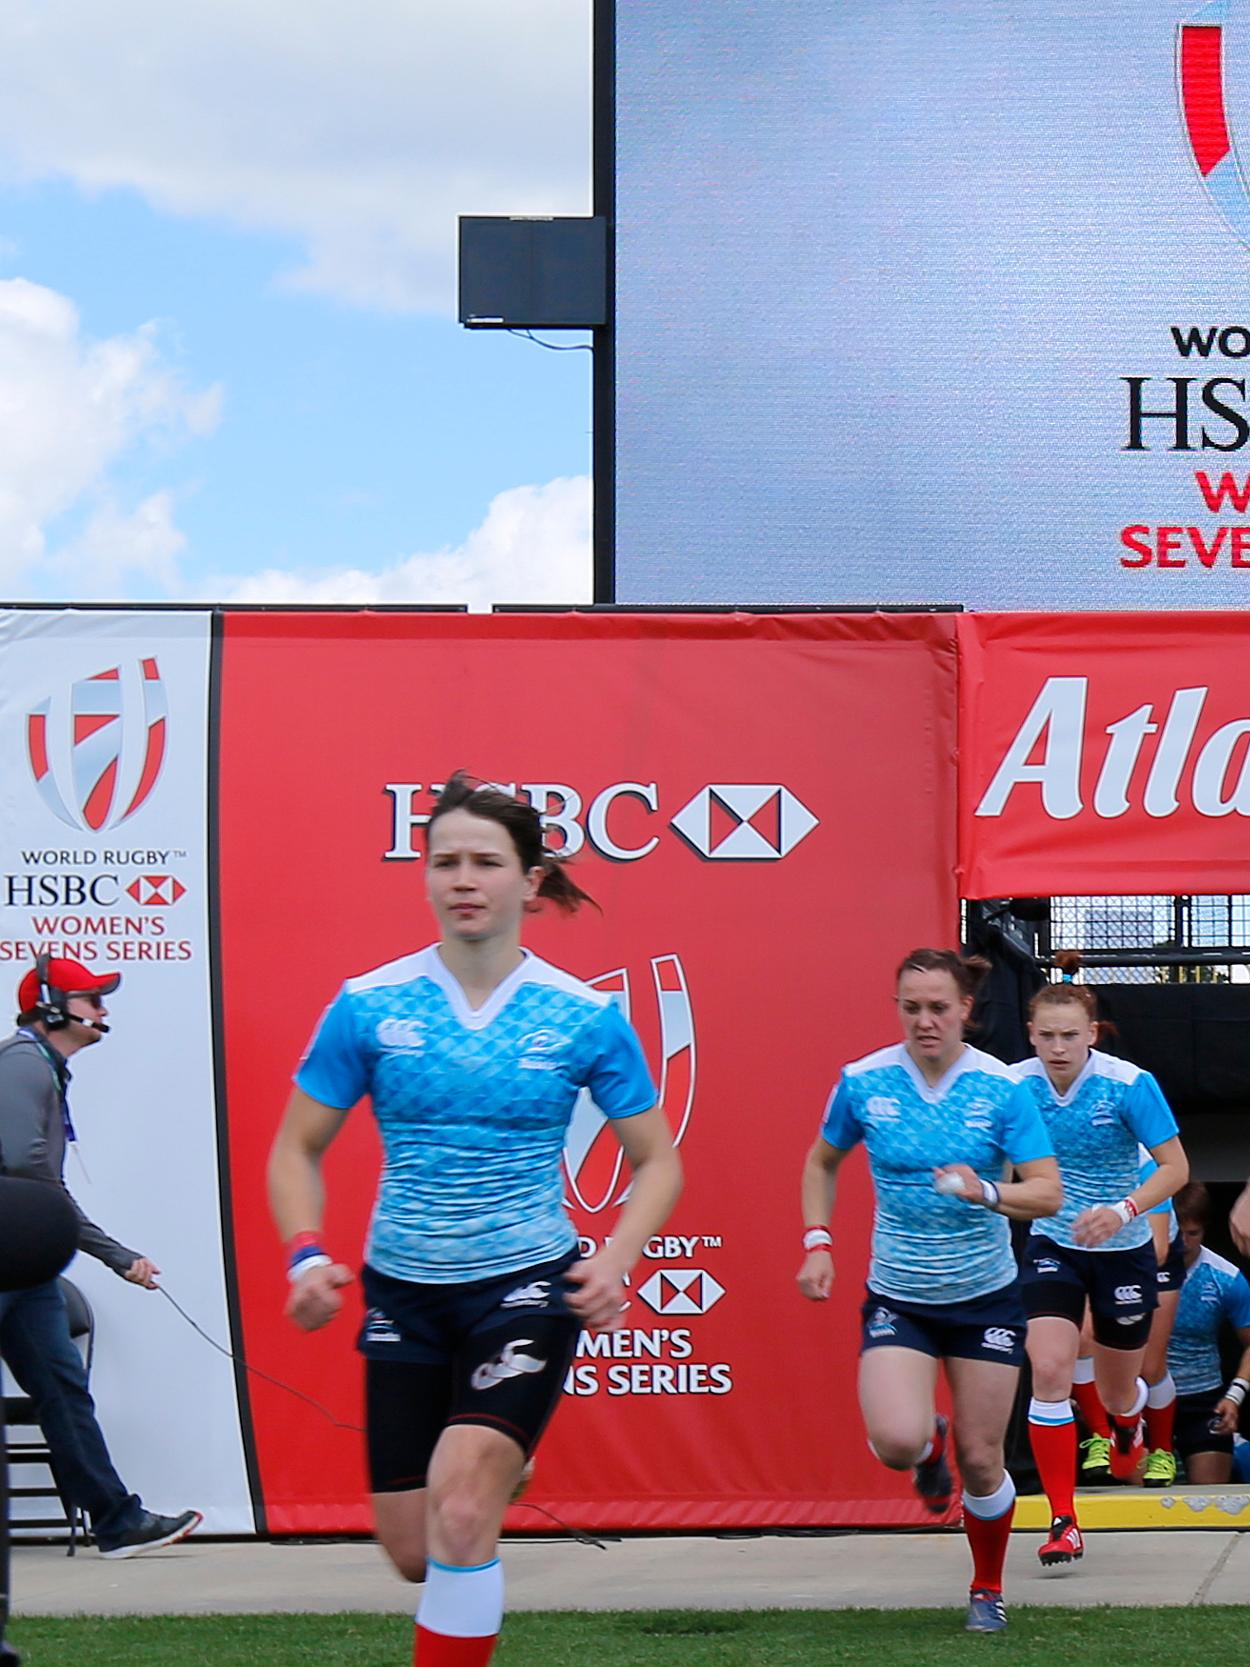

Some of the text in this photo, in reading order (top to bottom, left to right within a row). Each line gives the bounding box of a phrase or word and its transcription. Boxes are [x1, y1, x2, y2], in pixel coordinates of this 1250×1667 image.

[384, 782, 660, 860] HBC
[22, 850, 96, 865] WORLD
[5, 874, 119, 906] HSBC
[32, 915, 165, 936] WOMEN'S
[106, 940, 192, 961] SERIES
[576, 1329, 693, 1358] MEN'S
[607, 1364, 733, 1395] SERIES
